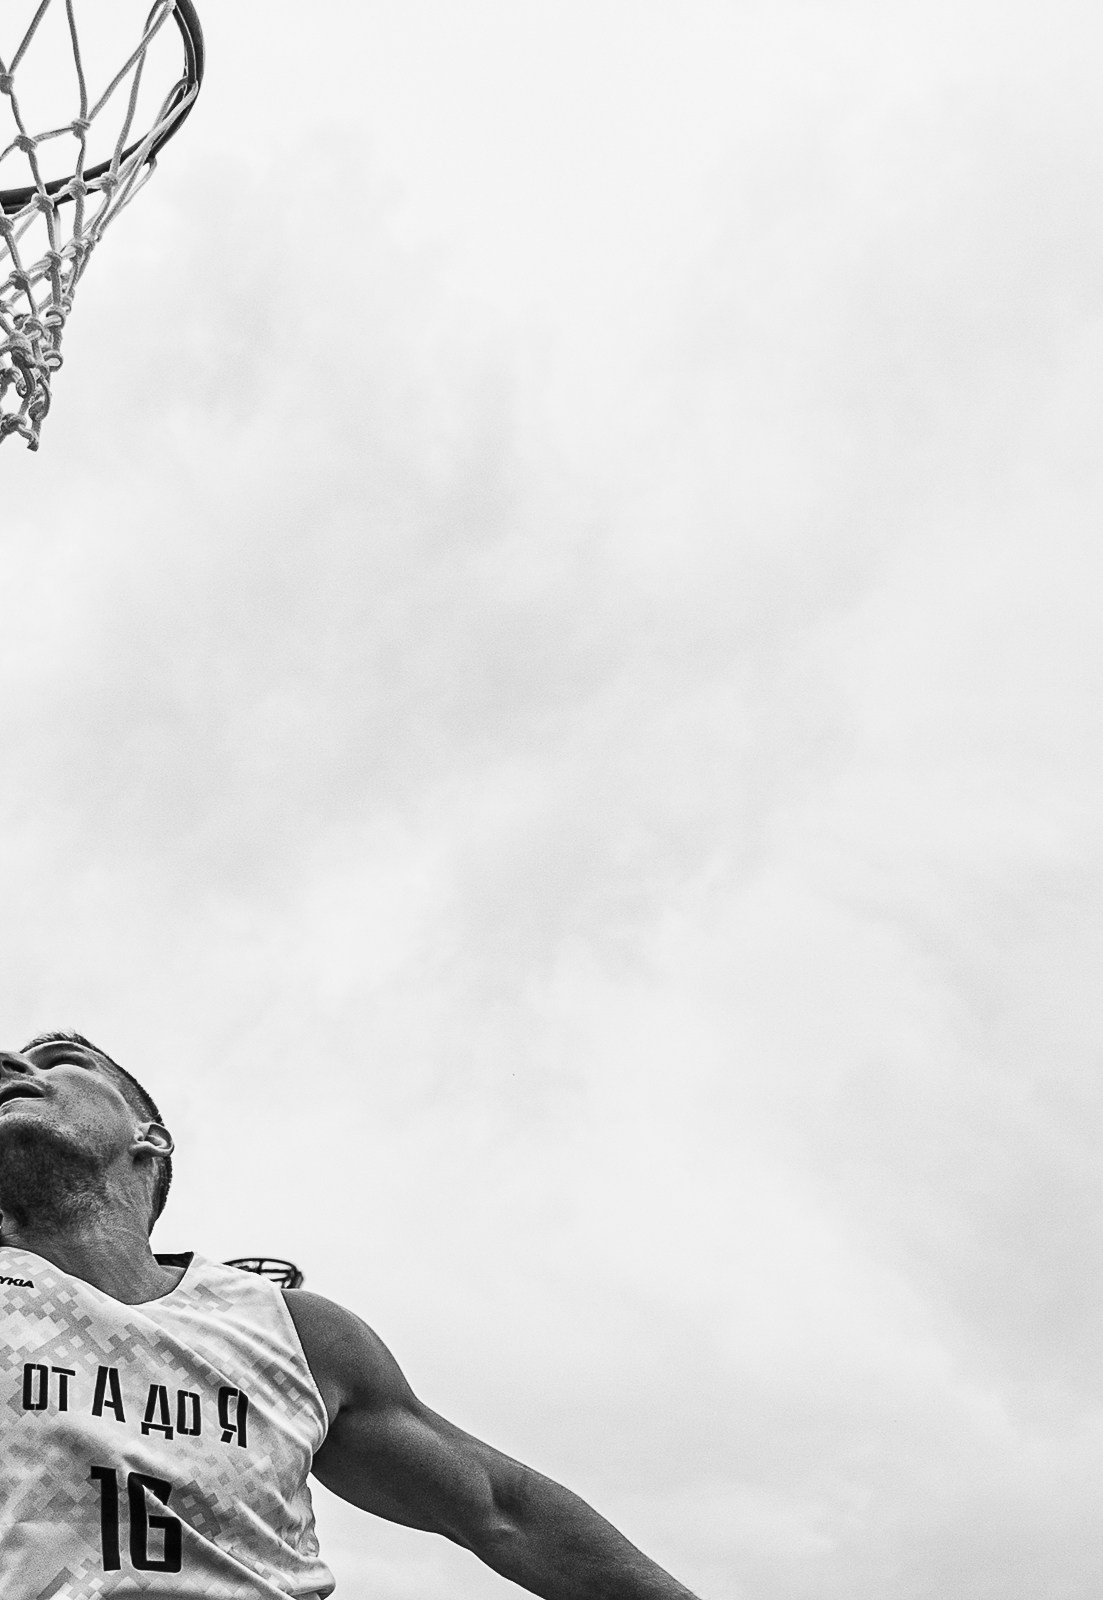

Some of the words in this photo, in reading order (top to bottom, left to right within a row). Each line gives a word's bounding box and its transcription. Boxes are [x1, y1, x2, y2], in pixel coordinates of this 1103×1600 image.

[91, 1365, 126, 1423] А
[217, 1386, 249, 1449] Я
[90, 1465, 182, 1574] 16
